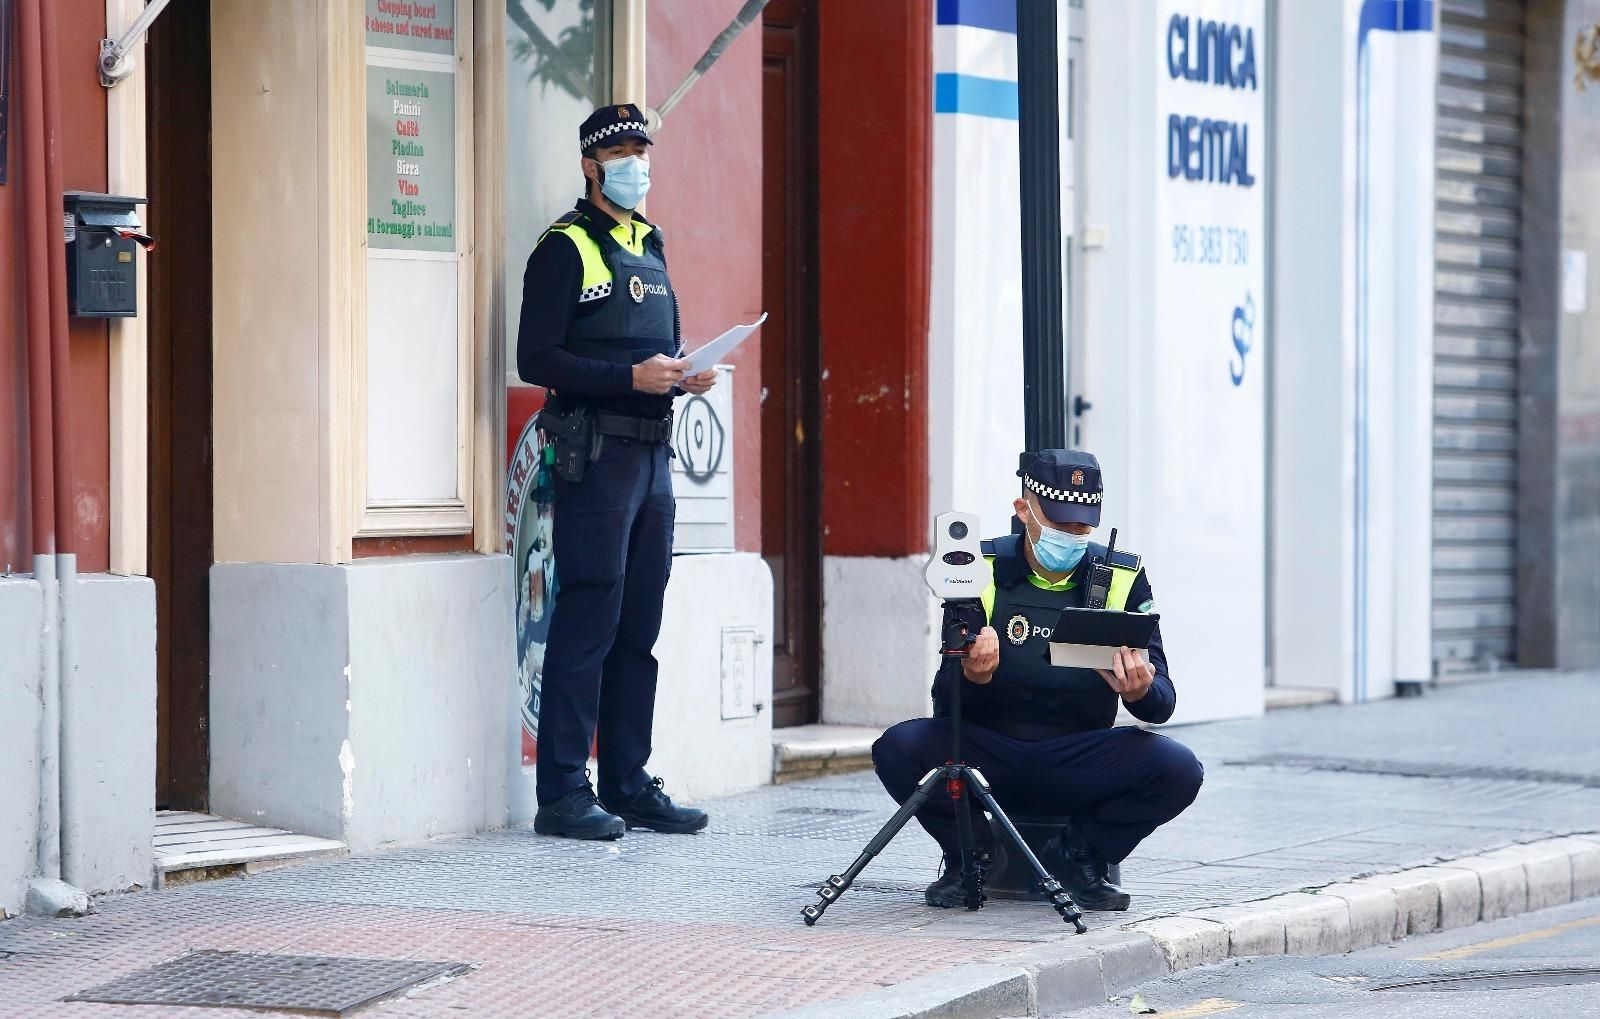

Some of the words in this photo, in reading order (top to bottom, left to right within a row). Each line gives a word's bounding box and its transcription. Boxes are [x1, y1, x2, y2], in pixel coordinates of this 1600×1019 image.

[414, 2, 436, 19] board
[371, 16, 394, 34] cheese
[396, 21, 409, 36] and
[411, 23, 432, 39] cured
[385, 79, 429, 98] Salumeria
[393, 99, 421, 117] Panini
[392, 139, 424, 157] Piadina
[1168, 114, 1255, 187] DENTAL
[396, 159, 420, 177] Birra
[398, 179, 419, 196] Vino
[391, 198, 426, 219] Tagliere
[376, 218, 415, 239] formaggi
[424, 221, 453, 238] salumi
